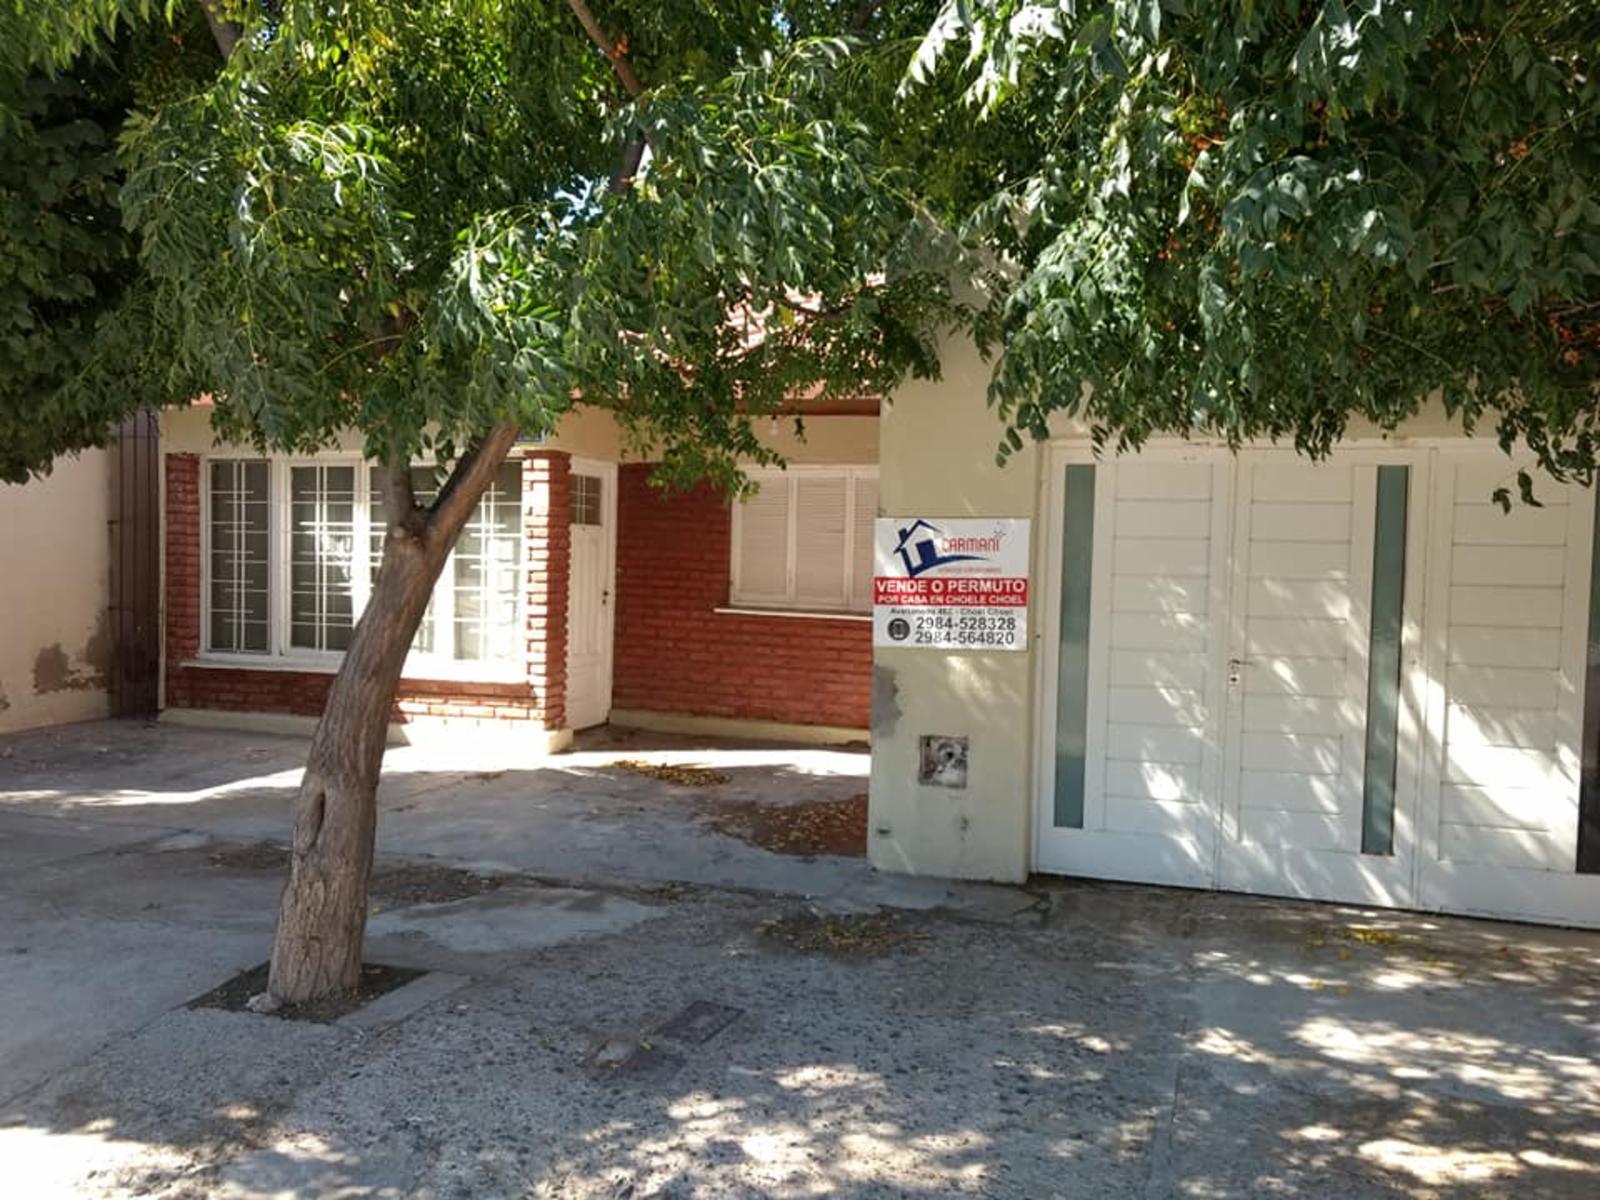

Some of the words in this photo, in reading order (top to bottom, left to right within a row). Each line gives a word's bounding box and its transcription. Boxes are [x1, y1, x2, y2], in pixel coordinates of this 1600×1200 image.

[942, 537, 999, 552] CARMANI
[877, 580, 927, 593] VENDE
[931, 580, 943, 593] O
[948, 580, 1025, 593] PERMUTO
[878, 594, 899, 604] POR
[900, 594, 928, 604] CASA
[930, 595, 942, 604] EN
[945, 595, 987, 604] CHOELE
[988, 595, 1023, 604] CHOEL
[916, 617, 1015, 630] 2984-528328
[915, 631, 1014, 644] 2984-564820
